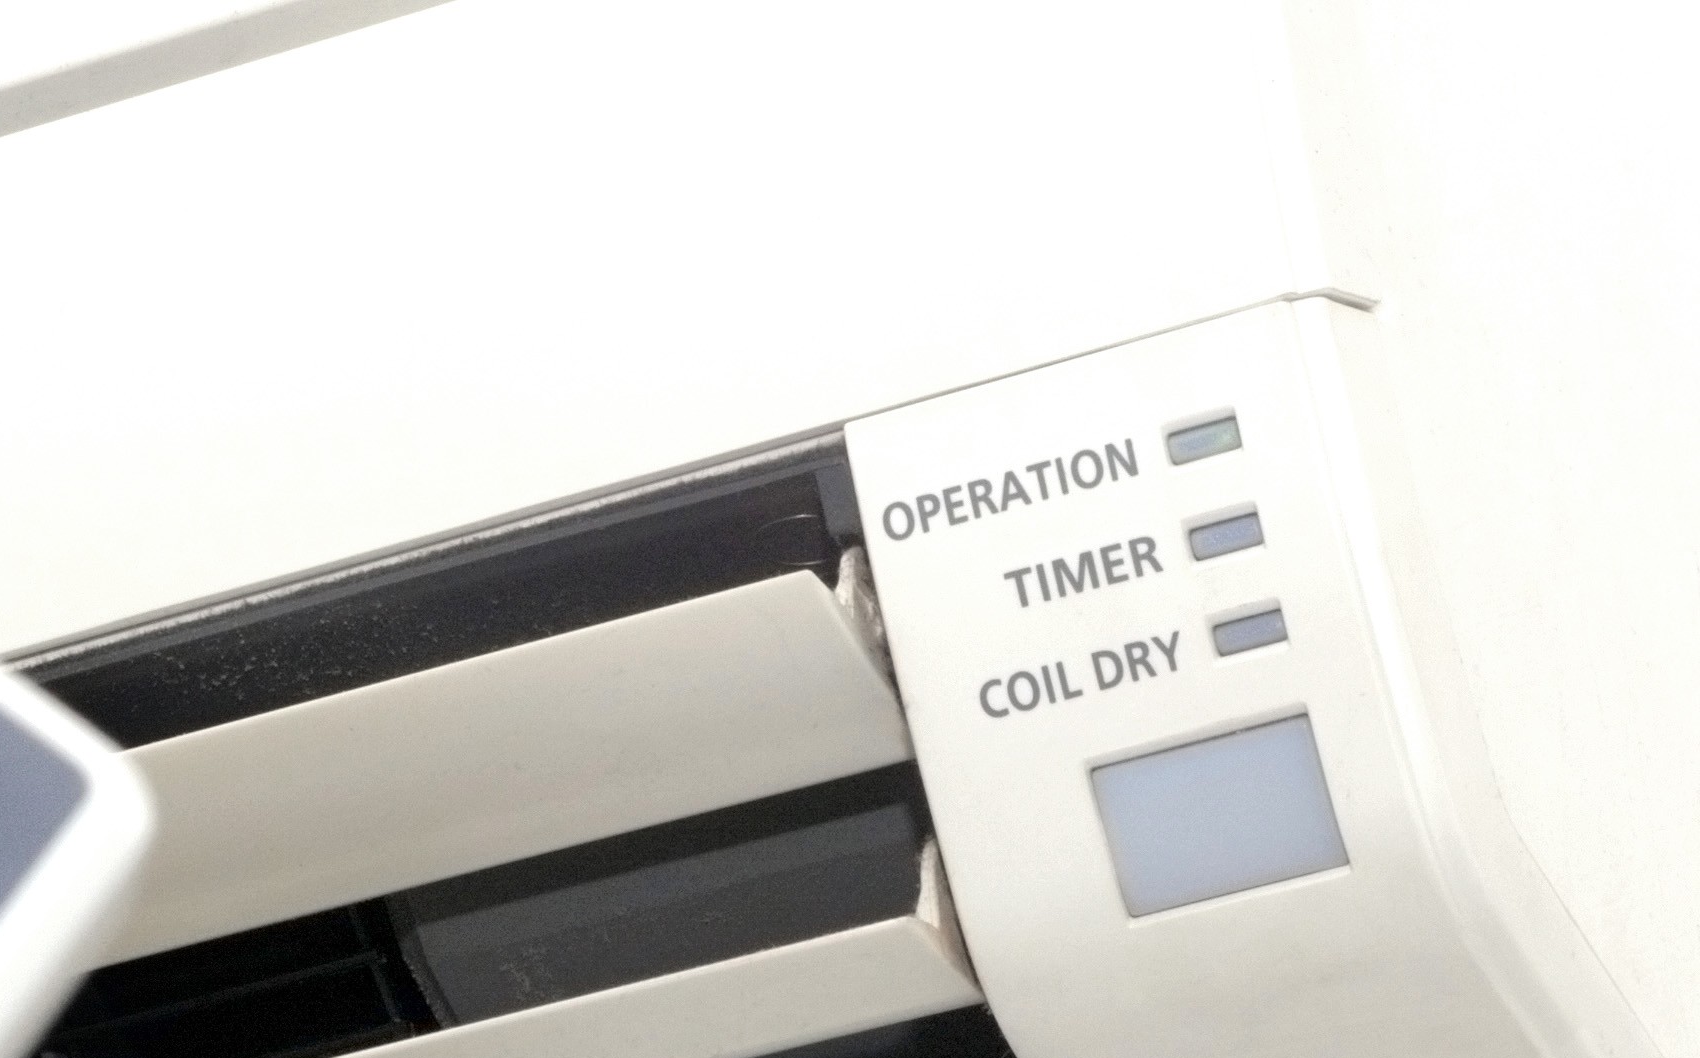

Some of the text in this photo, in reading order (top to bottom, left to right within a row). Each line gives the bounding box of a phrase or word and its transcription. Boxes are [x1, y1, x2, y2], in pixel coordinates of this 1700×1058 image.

[882, 438, 1140, 542] OPERATION
[1003, 536, 1164, 608] TIMER
[978, 631, 1181, 719] COIL DRY
